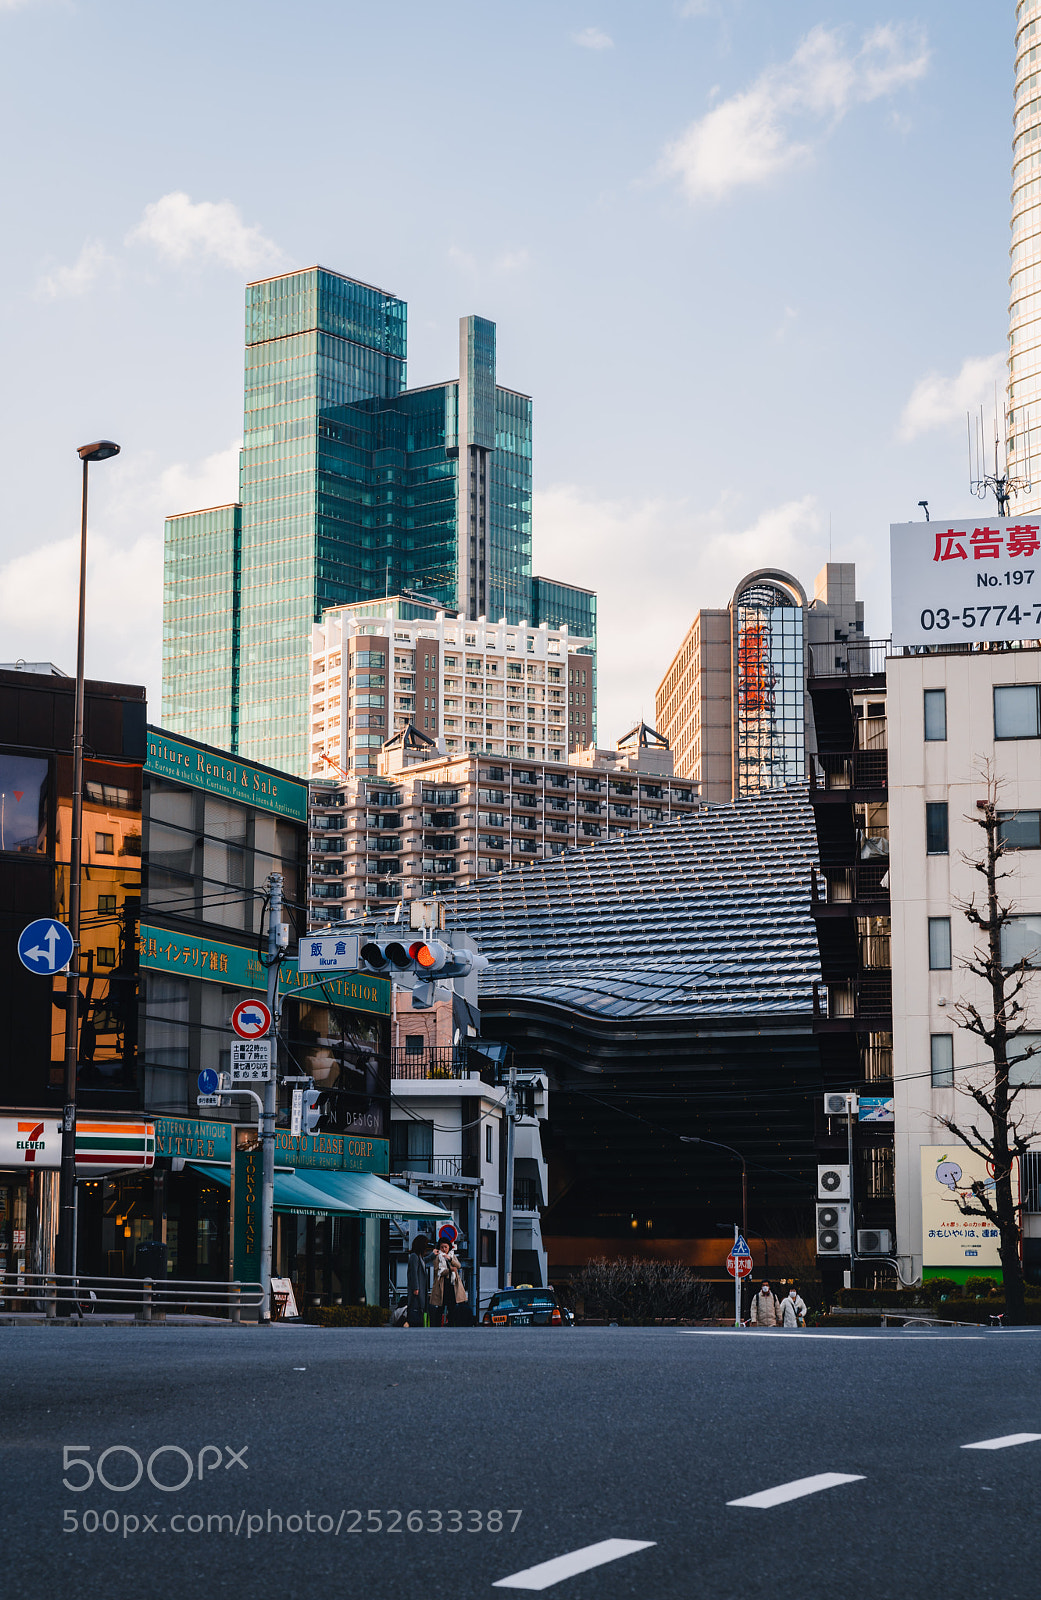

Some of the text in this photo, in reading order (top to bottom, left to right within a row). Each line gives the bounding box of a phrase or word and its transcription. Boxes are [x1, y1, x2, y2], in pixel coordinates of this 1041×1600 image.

[933, 525, 1041, 562] 広告募
[976, 570, 1035, 587] No.197
[147, 740, 278, 797] niture Rental & Sale
[310, 940, 347, 957] 飯倉
[346, 1111, 379, 1128] DESIGN
[187, 1123, 192, 1135] &
[194, 1125, 226, 1139] ANTIQUE
[275, 1133, 375, 1157] TOKYO LEASE CORP.
[246, 1155, 256, 1203] TOKYO
[245, 1205, 256, 1254] LEASE
[928, 1229, 1001, 1238] おもいやりは、連鎖
